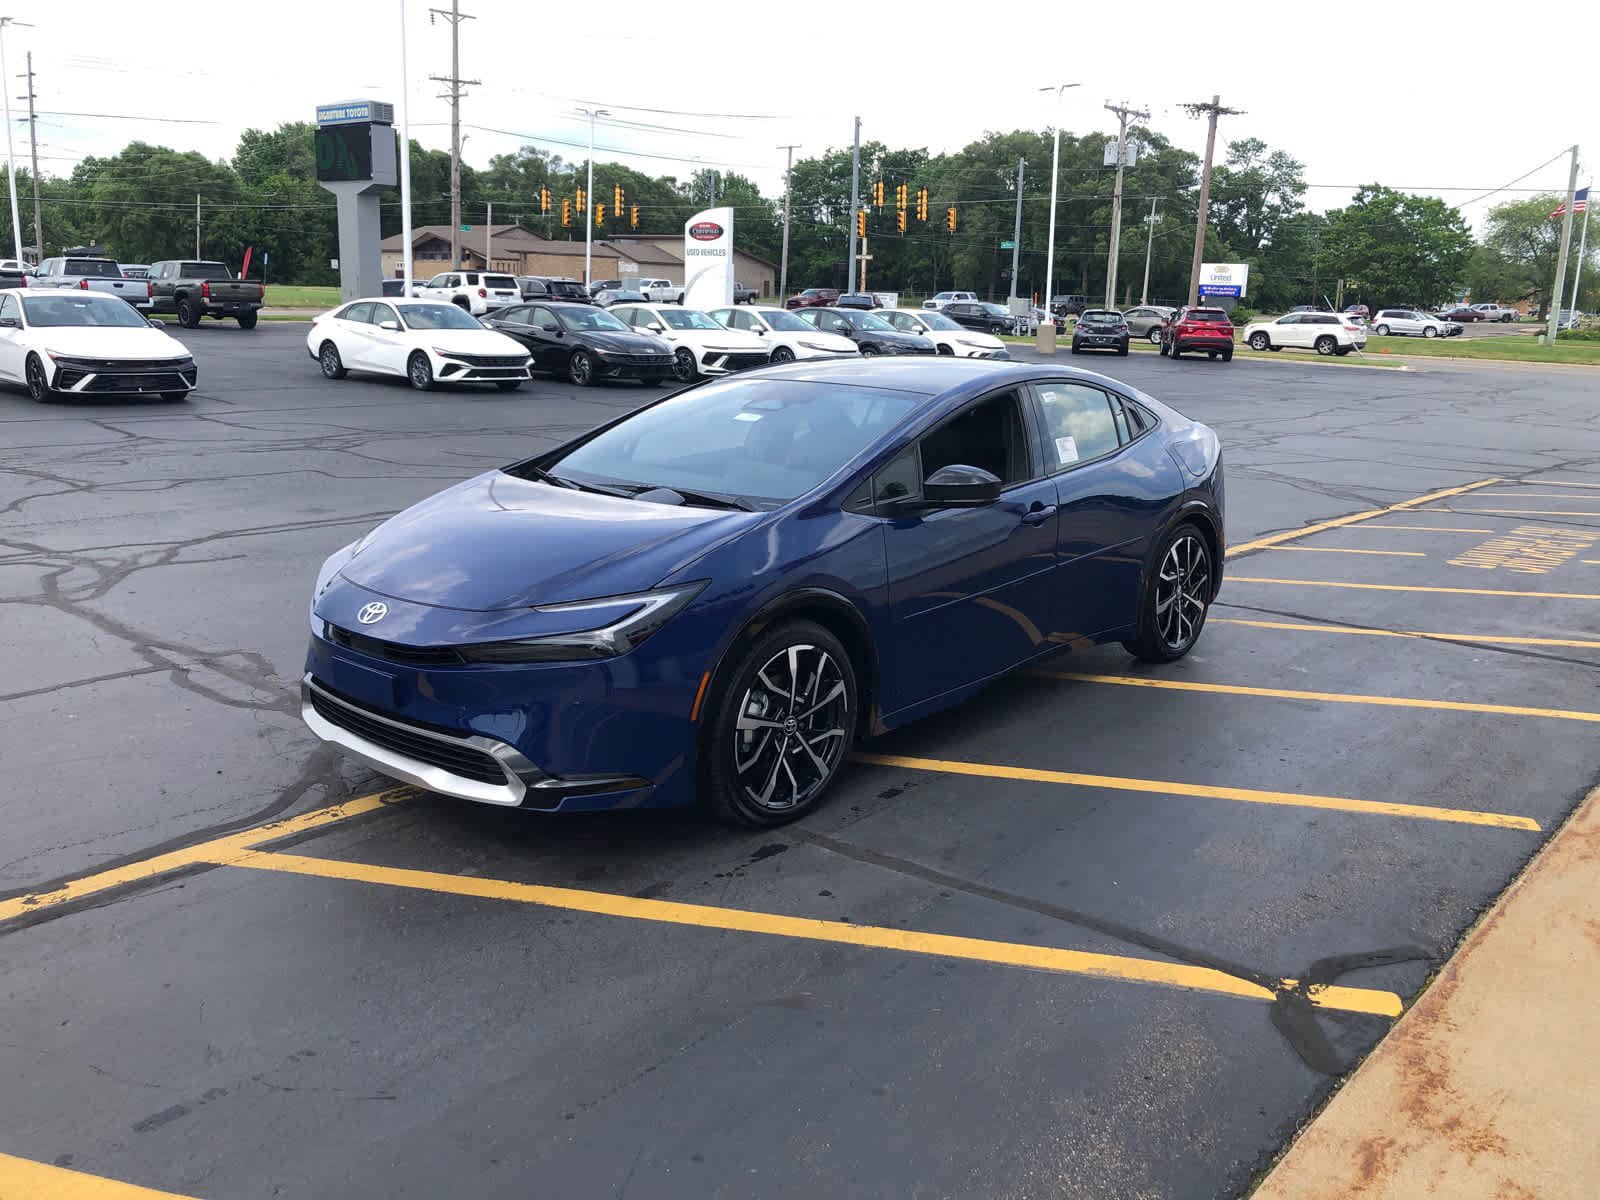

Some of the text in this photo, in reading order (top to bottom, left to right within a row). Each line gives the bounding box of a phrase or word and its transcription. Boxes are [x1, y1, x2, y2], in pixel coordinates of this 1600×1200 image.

[687, 248, 726, 256] USED VEHICLES
[1210, 273, 1232, 281] United
